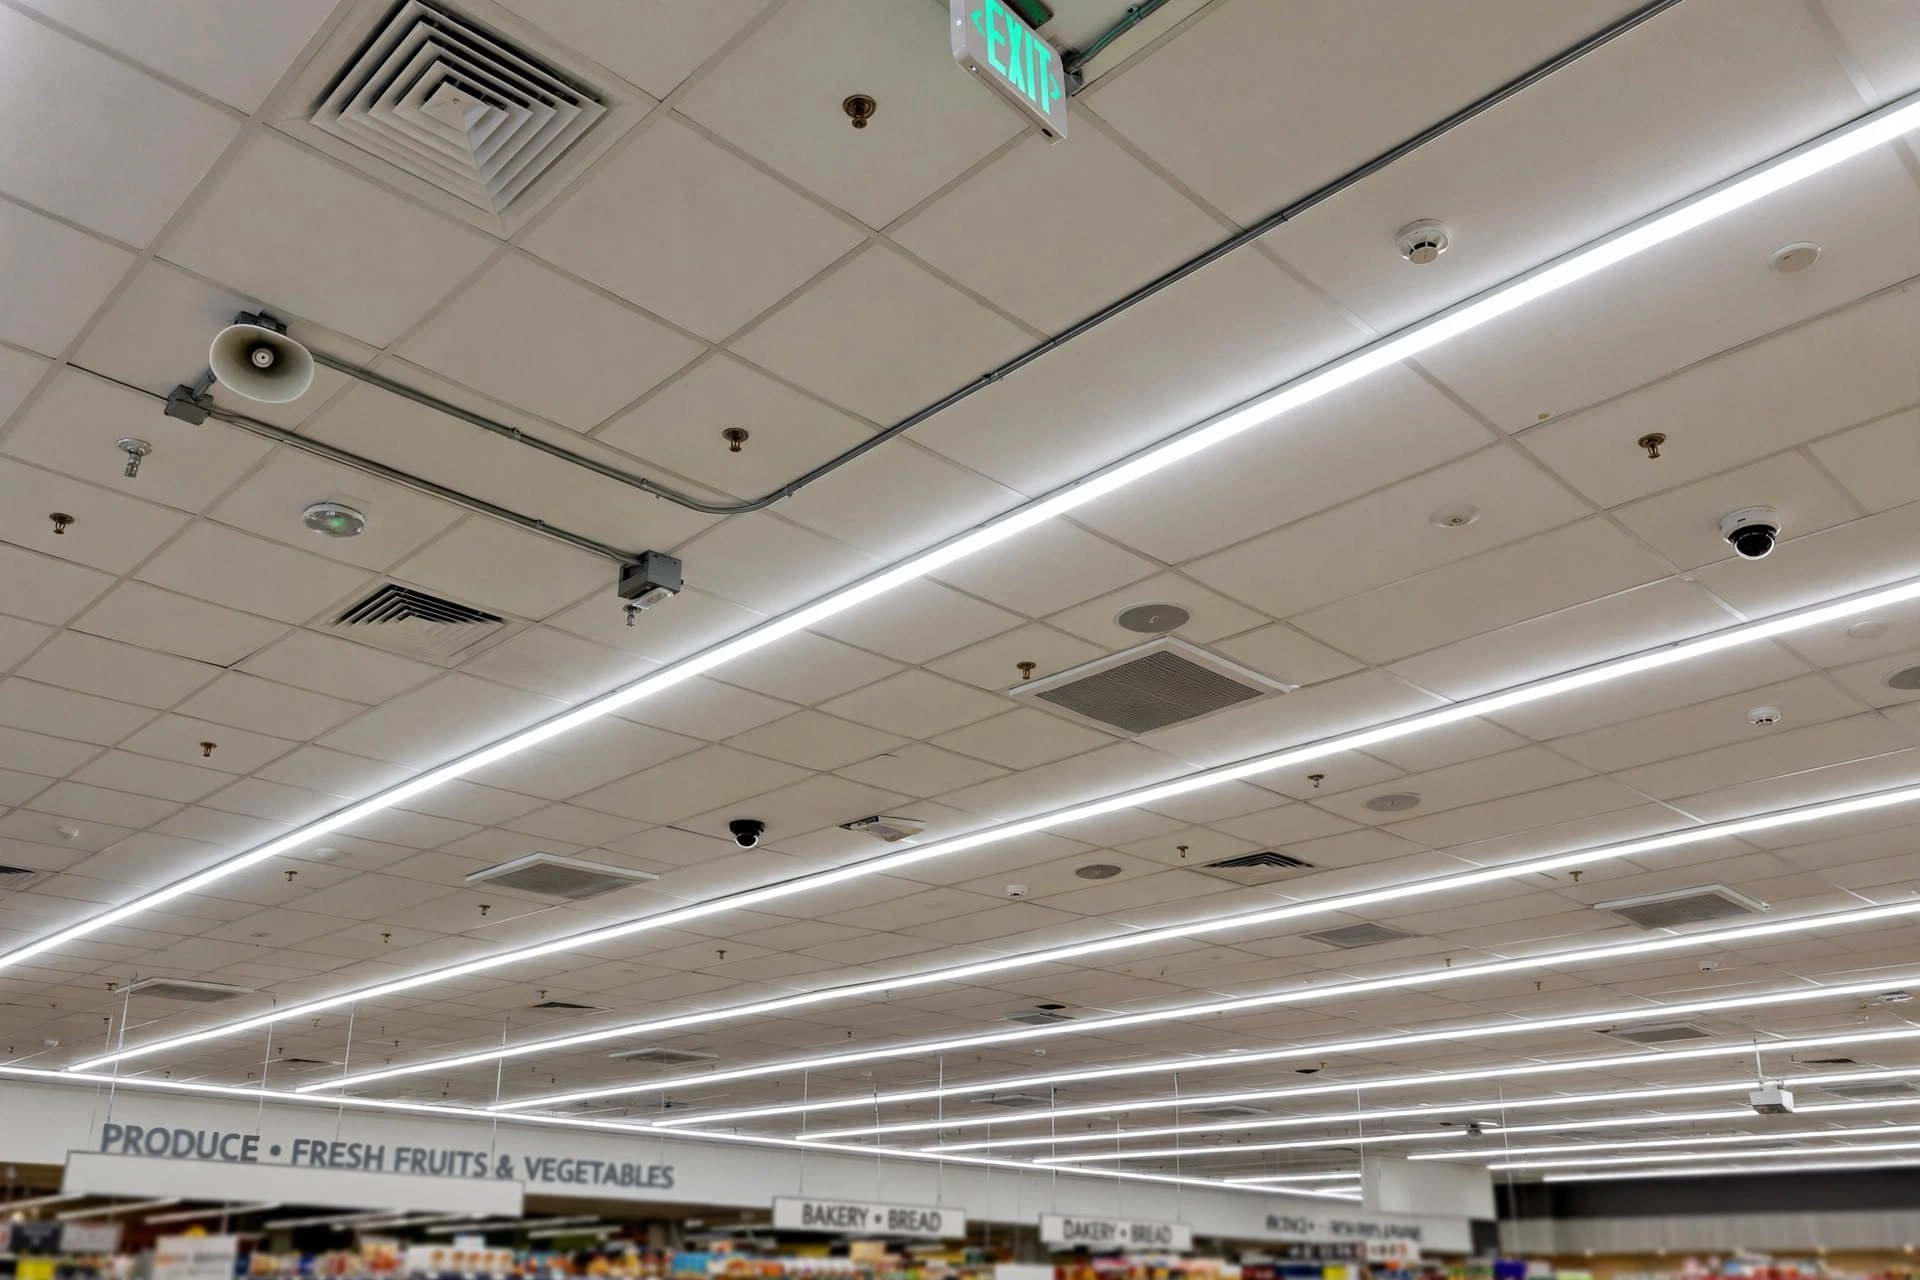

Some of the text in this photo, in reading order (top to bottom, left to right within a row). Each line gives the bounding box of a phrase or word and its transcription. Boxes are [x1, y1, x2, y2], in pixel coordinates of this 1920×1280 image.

[985, 0, 1051, 115] EXIT
[101, 1123, 675, 1189] PRODUCE FRESH FRUITS & VEGETABLES
[802, 1203, 942, 1233] BAKERY BREAD
